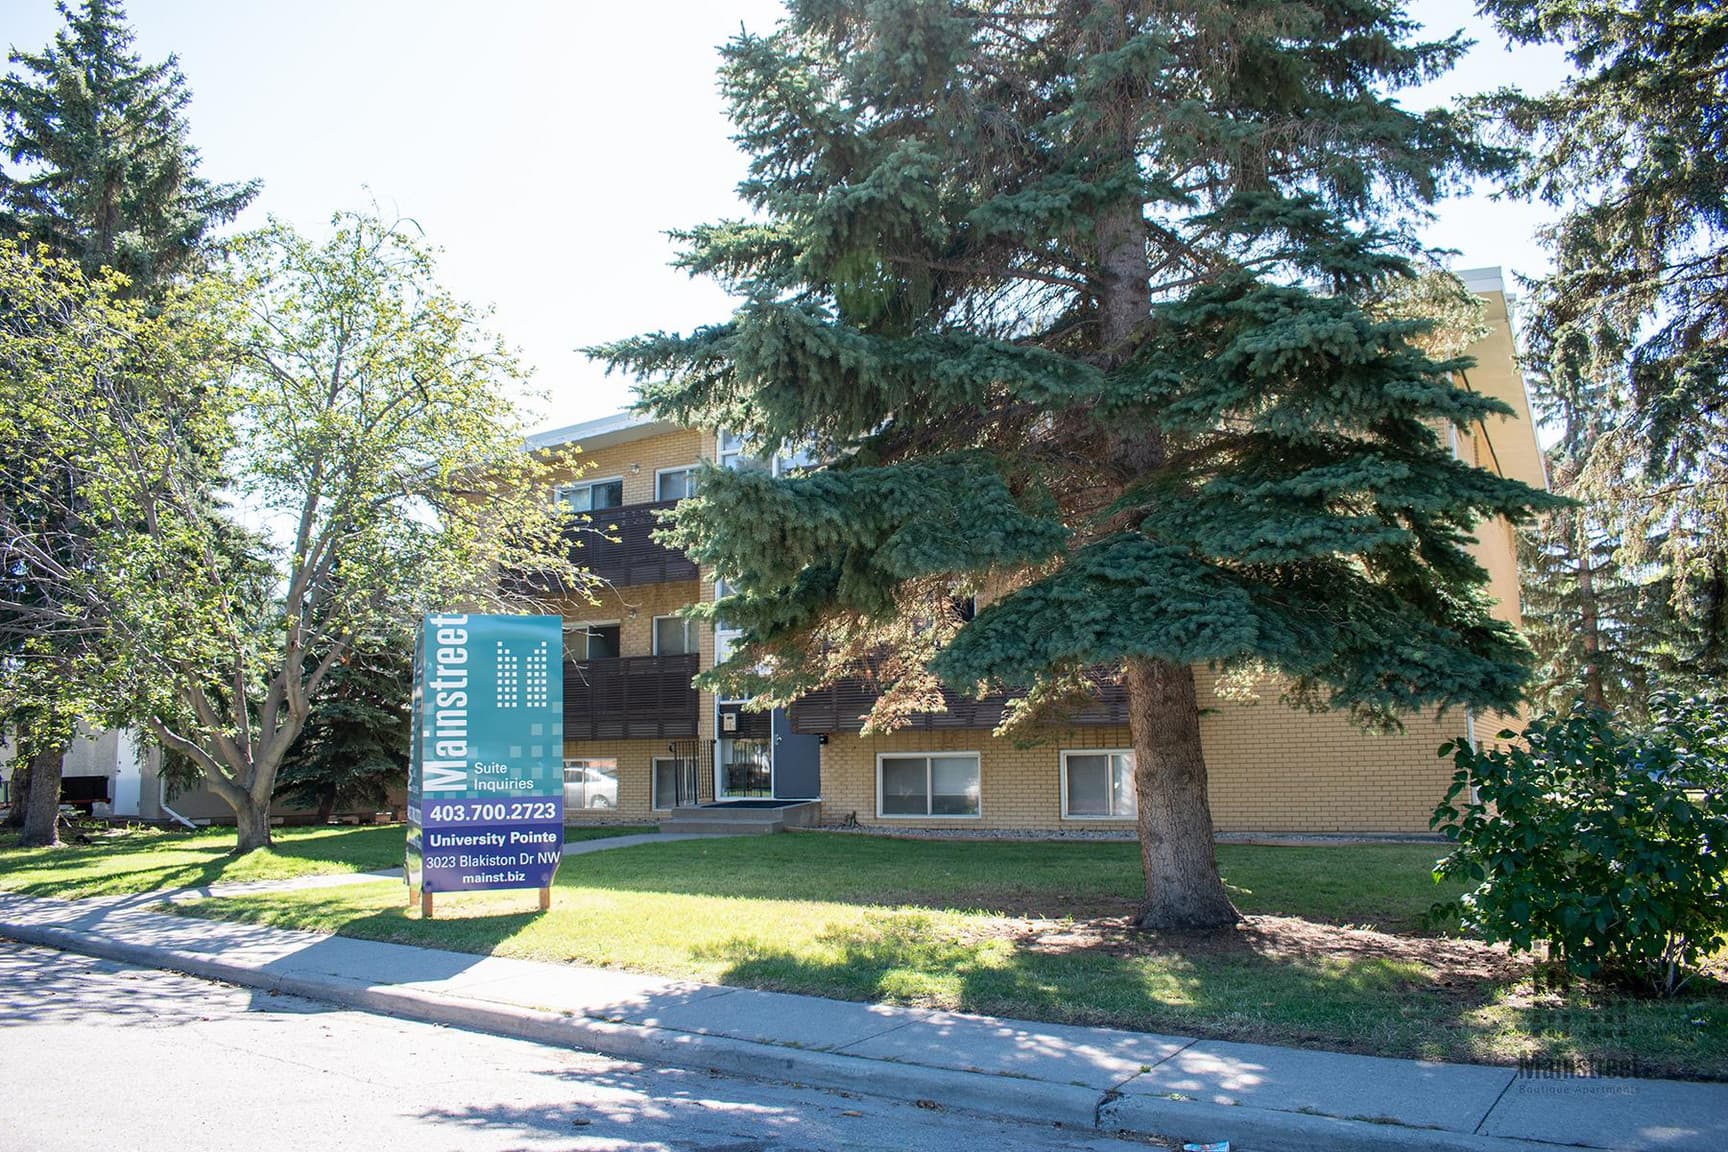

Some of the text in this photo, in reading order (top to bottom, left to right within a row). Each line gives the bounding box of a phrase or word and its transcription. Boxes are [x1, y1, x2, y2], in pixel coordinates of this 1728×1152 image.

[422, 614, 468, 792] Mainstreet
[474, 762, 508, 775] Suite
[474, 778, 534, 792] Inquiries
[430, 802, 556, 822] 403.700.2723
[430, 833, 506, 847] University
[510, 831, 557, 844] Pointe
[426, 851, 561, 868] 3023 Blakiston Dr NW
[462, 871, 526, 884] mainst.biz
